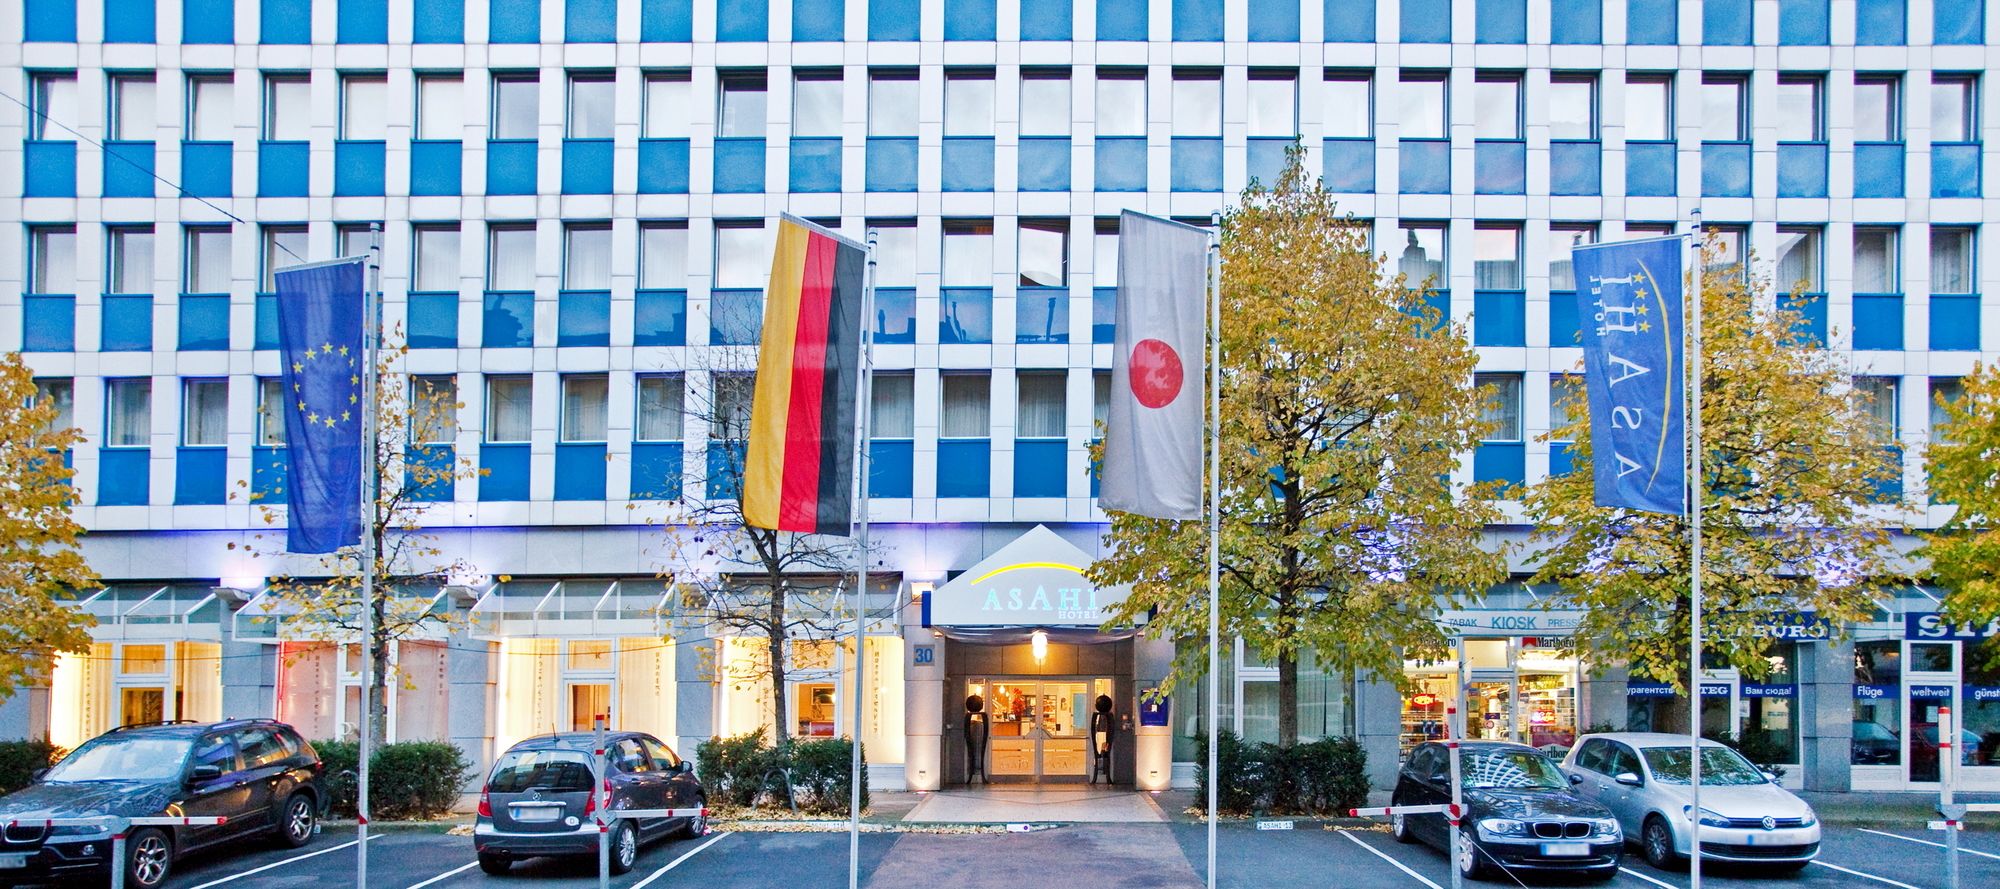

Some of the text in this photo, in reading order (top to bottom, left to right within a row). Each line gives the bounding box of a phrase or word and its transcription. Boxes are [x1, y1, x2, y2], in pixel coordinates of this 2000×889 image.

[982, 585, 1098, 611] ASAHI
[1058, 610, 1098, 619] HOTEL
[1448, 618, 1477, 627] TABAK
[1491, 616, 1537, 630] KIOSK
[1536, 637, 1575, 648] Marlboro
[915, 648, 933, 663] 30
[1626, 687, 1676, 695] урагентств
[1699, 686, 1729, 695] TEG
[1745, 686, 1792, 696] Вам сюда!
[1857, 686, 1883, 699] Flüge
[1911, 686, 1950, 697] weltweit
[1974, 688, 2000, 700] günst
